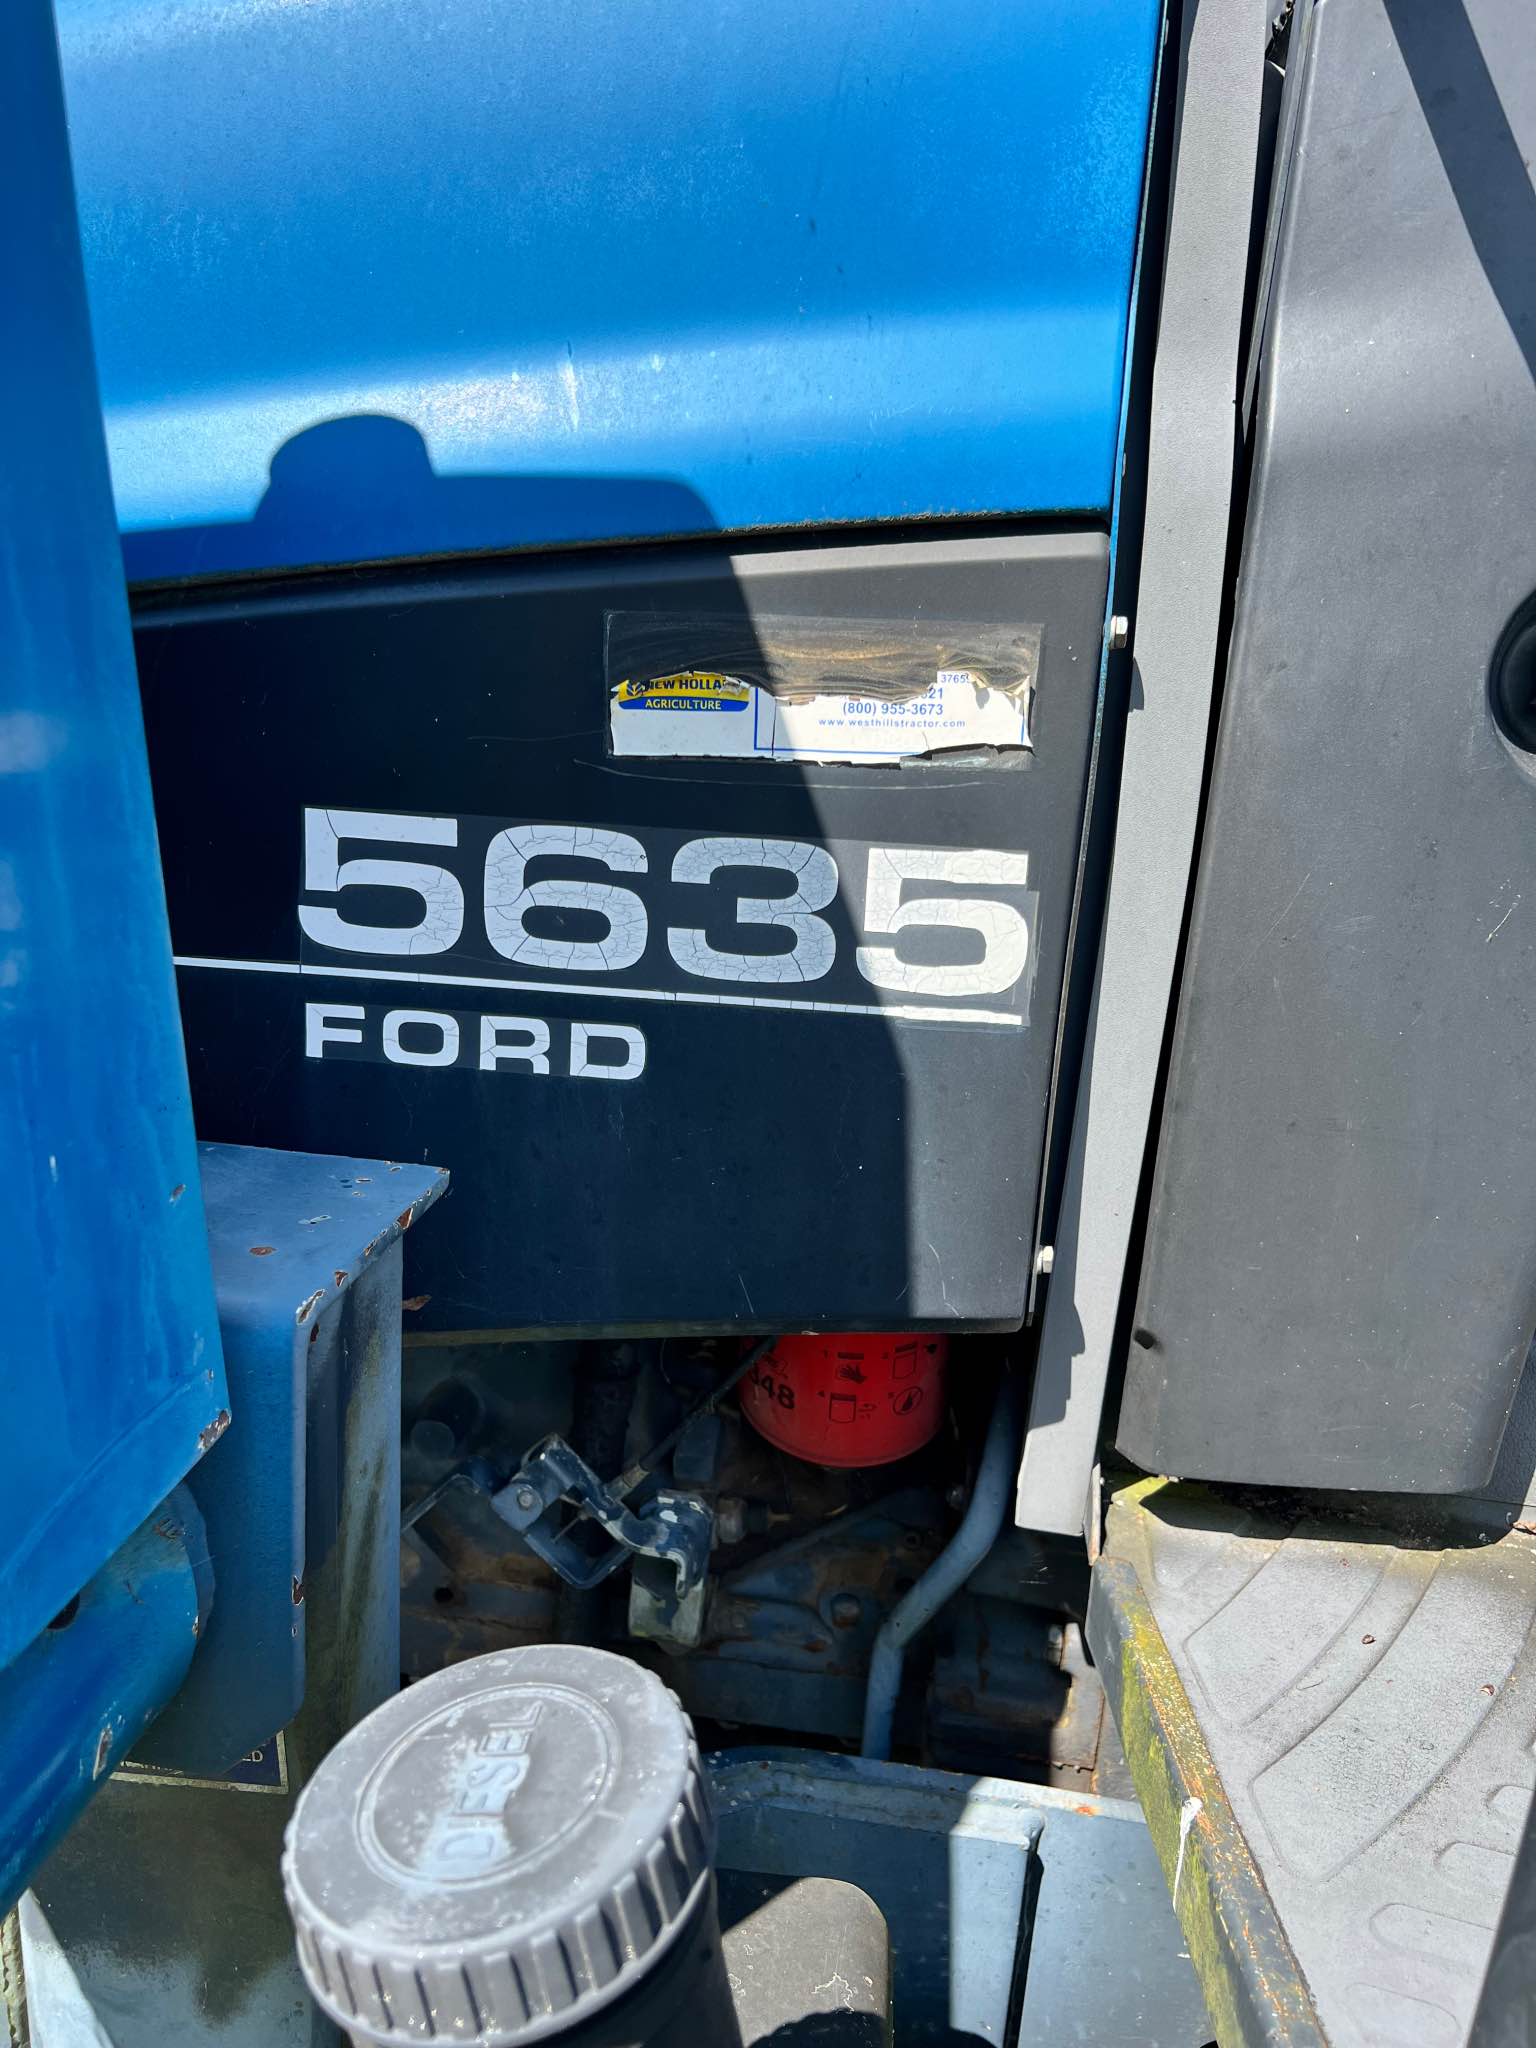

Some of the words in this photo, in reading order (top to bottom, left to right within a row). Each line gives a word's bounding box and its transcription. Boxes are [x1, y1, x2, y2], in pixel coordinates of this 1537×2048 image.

[645, 699, 722, 711] AGRICULTURE
[678, 678, 727, 691] HOLLA
[842, 702, 877, 717] (800)
[881, 702, 944, 716] 955-3673
[298, 806, 1030, 998] 5635
[304, 1001, 647, 1081] FORD
[433, 1699, 545, 1866] DIESEL
